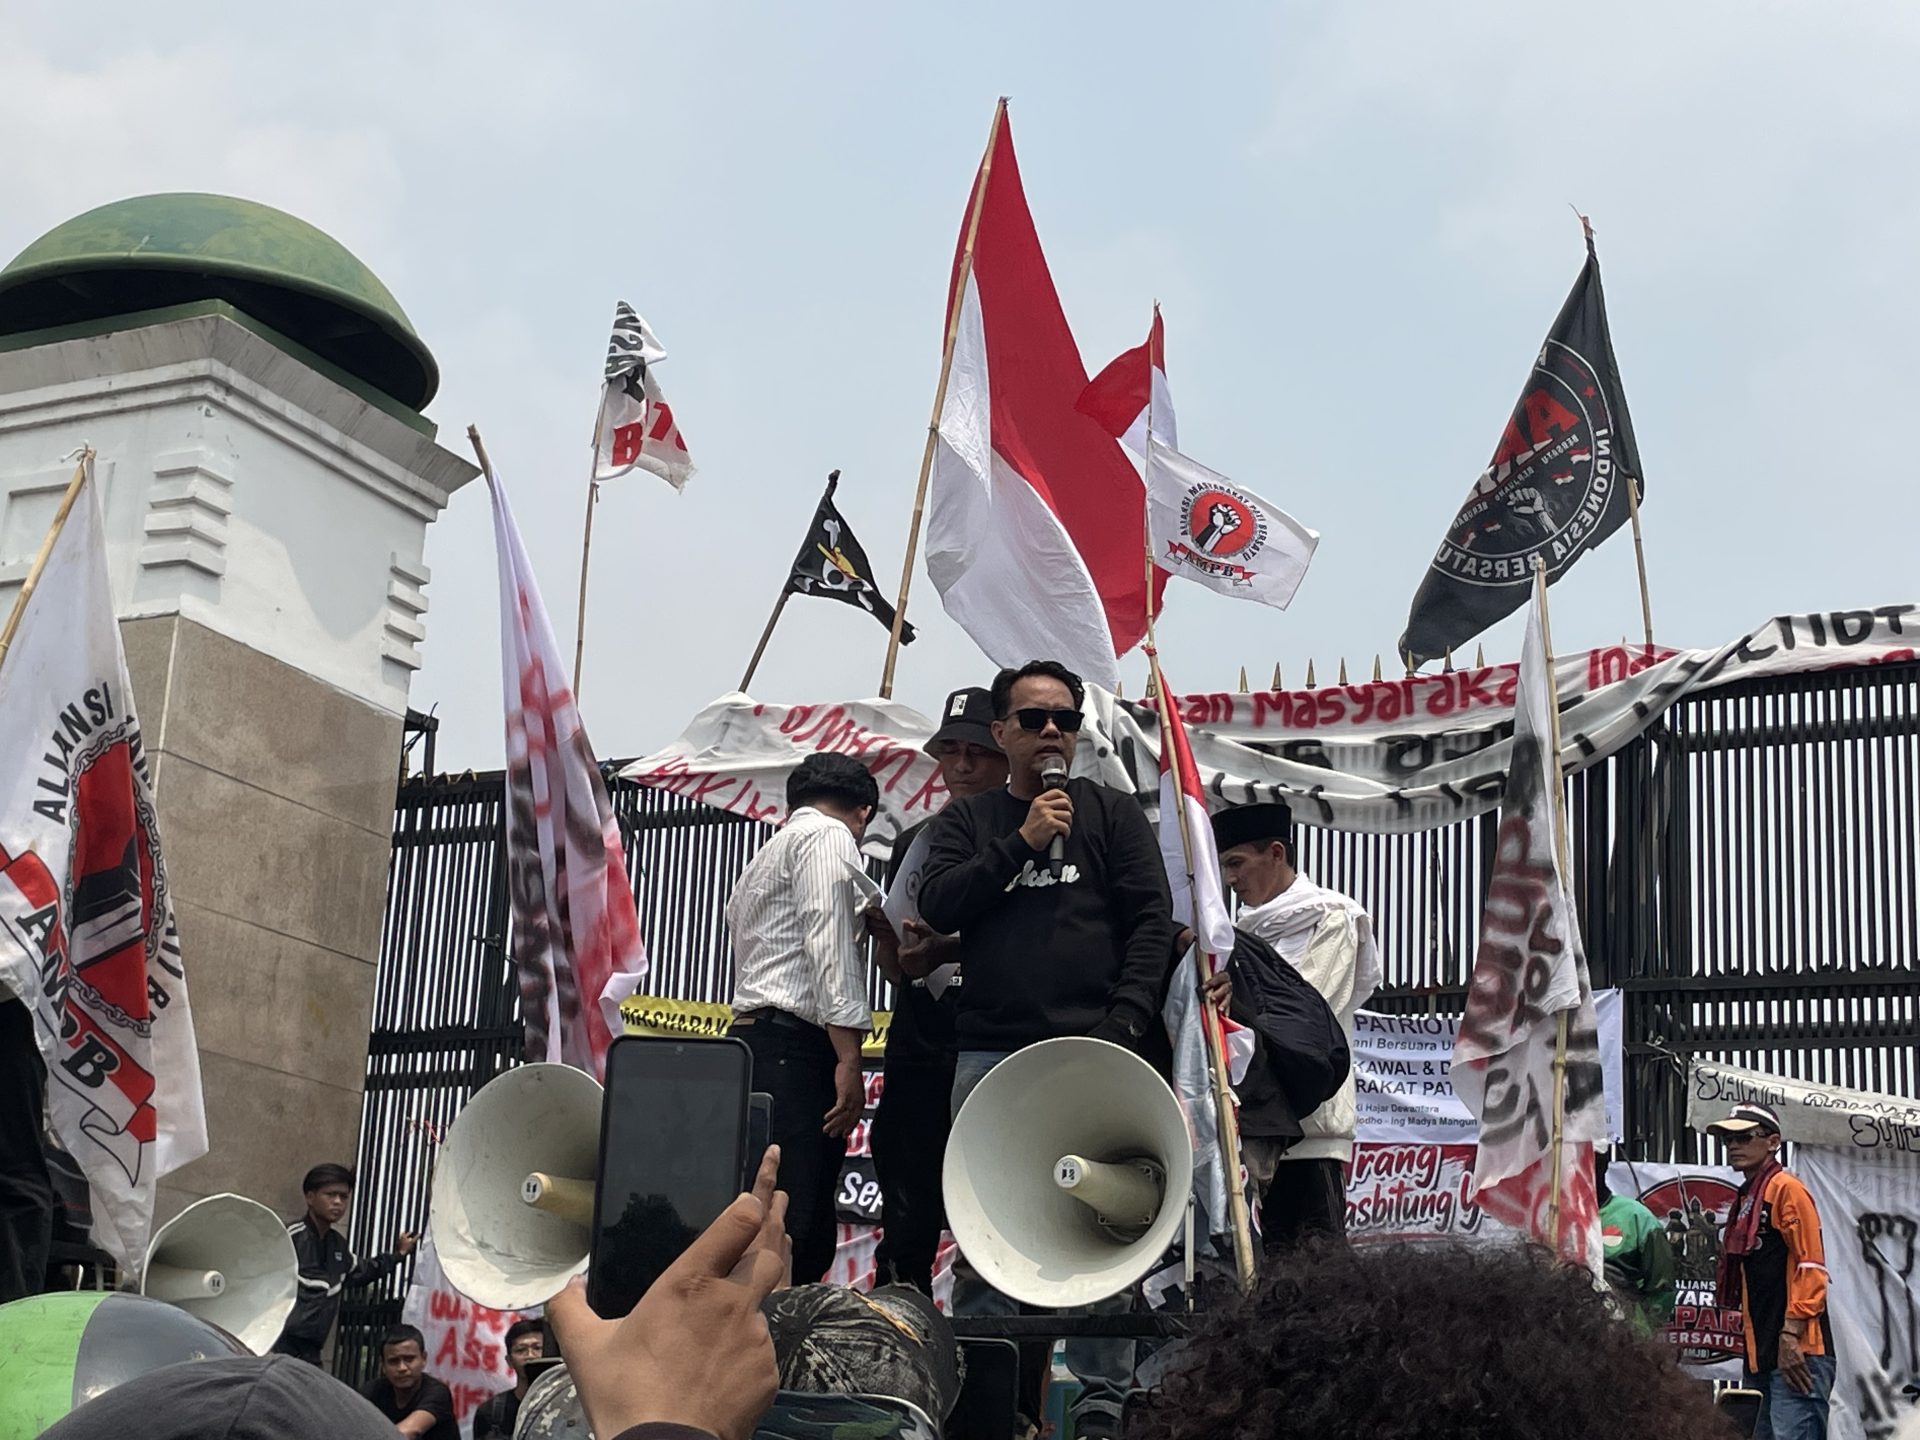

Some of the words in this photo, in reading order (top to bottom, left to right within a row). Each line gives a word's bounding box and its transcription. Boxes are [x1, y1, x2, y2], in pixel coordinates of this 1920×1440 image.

[1180, 497, 1192, 536] ALIANSI
[1243, 524, 1268, 561] BERSATU
[1184, 550, 1234, 576] AMPB
[33, 681, 114, 825] ALIANSI
[1353, 1038, 1372, 1049] ani
[1377, 1038, 1437, 1051] Bersuara
[1422, 1061, 1434, 1075] &
[1355, 1079, 1417, 1095] RAKAT
[1423, 1081, 1453, 1096] PAT
[1366, 1104, 1388, 1113] Hajar
[1391, 1104, 1439, 1112] Dewantara
[1408, 1116, 1437, 1127] Madya
[1355, 1146, 1438, 1189] rang
[1675, 1279, 1717, 1291] LIANS
